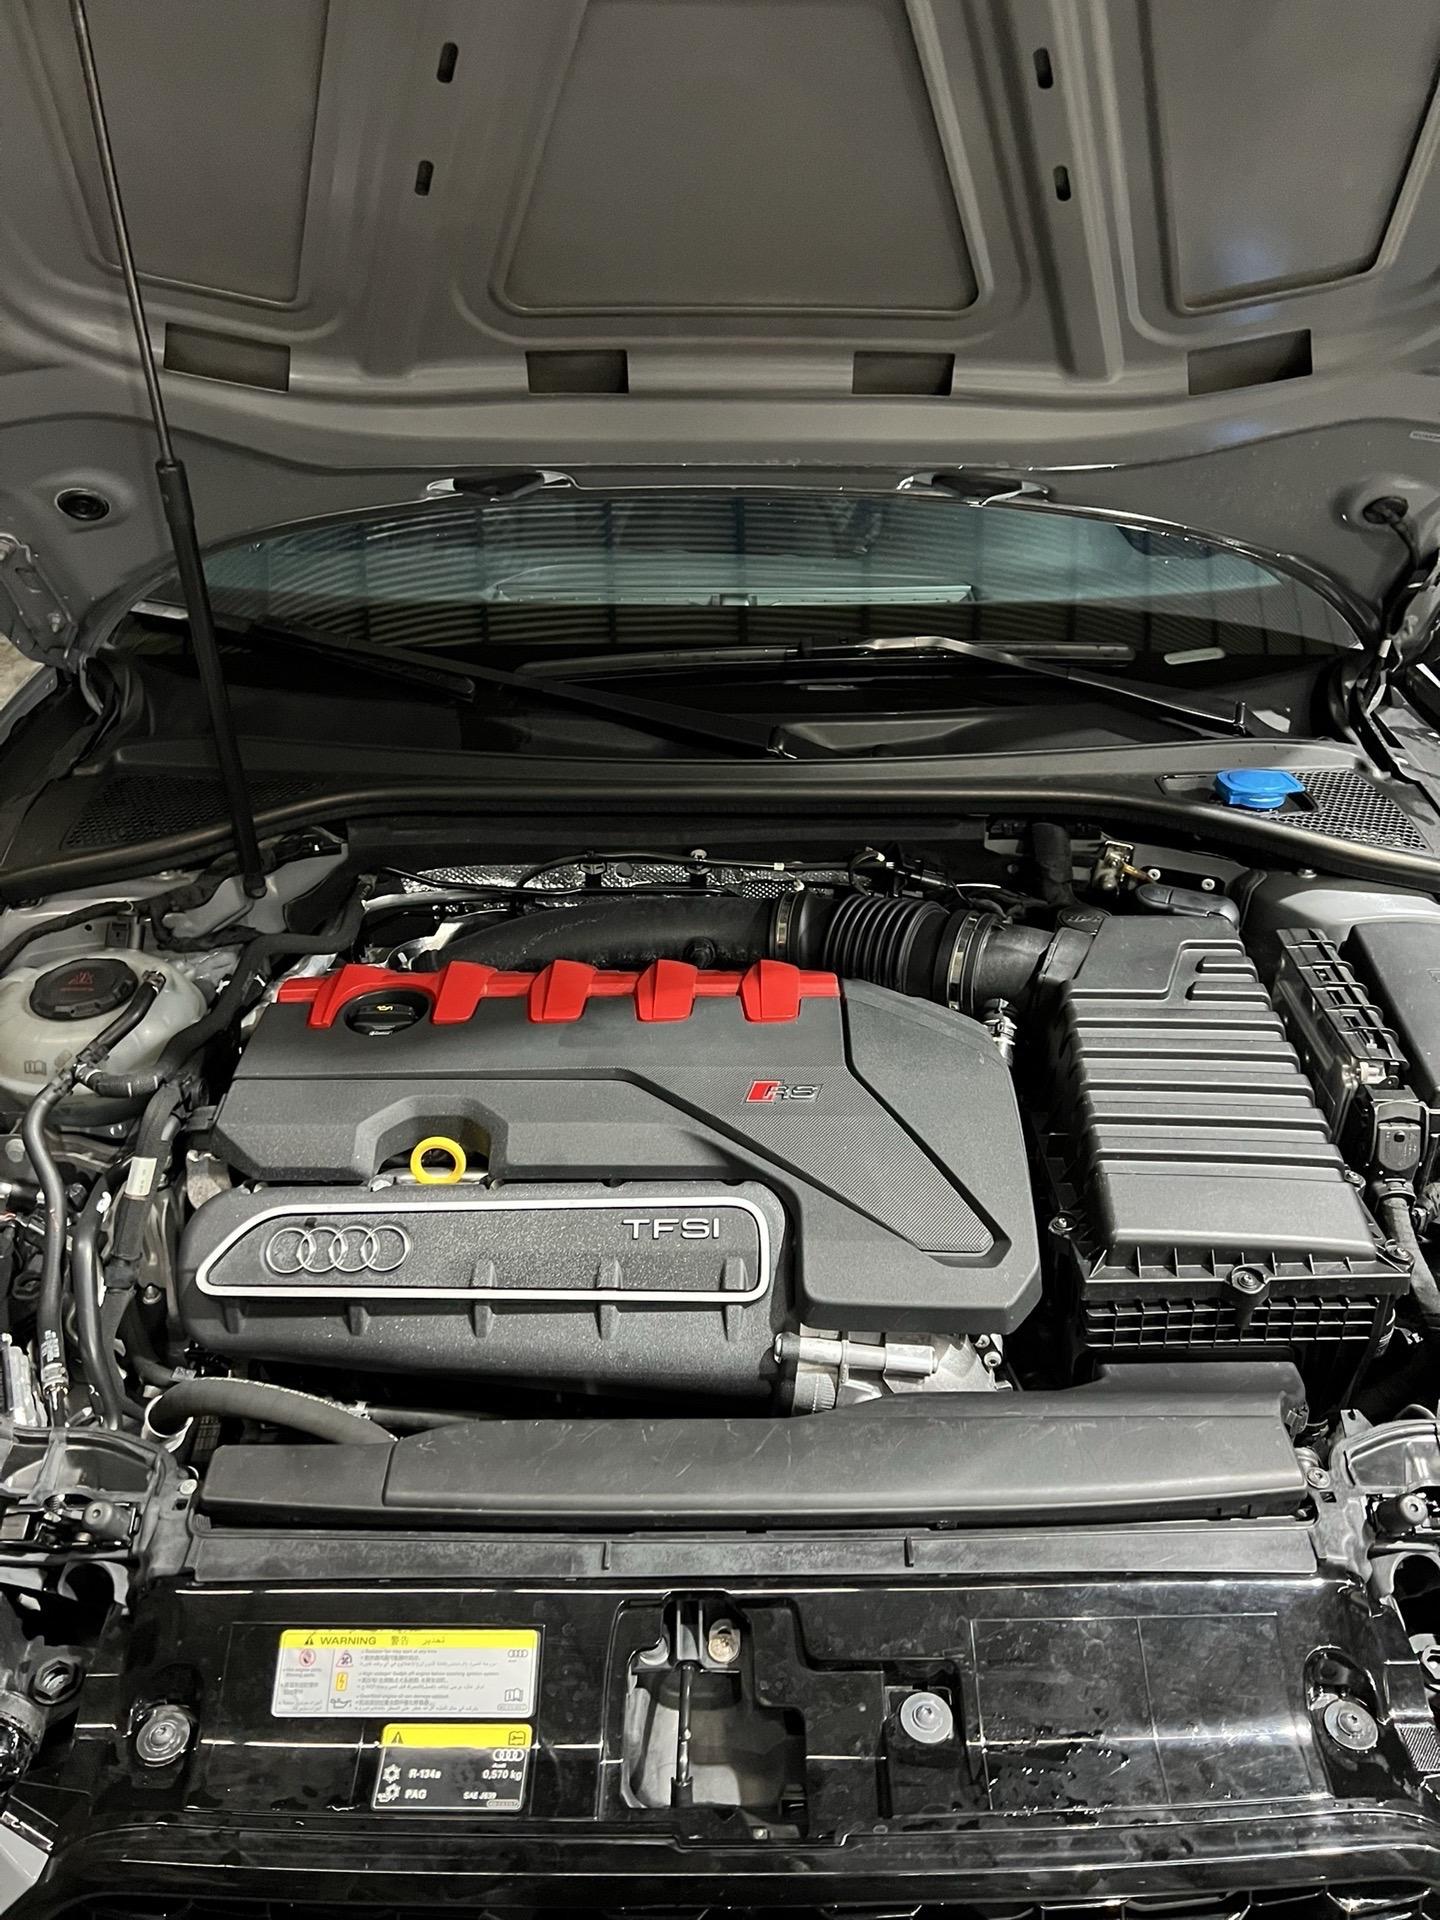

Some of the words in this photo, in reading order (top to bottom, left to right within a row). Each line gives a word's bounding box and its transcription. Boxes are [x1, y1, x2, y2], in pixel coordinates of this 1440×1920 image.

[622, 1217, 720, 1240] TFSI
[320, 1636, 377, 1646] WARNING
[408, 1768, 442, 1779] R-134a
[482, 1769, 508, 1780] 0,570
[509, 1769, 523, 1781] kg
[404, 1789, 428, 1800] PAG
